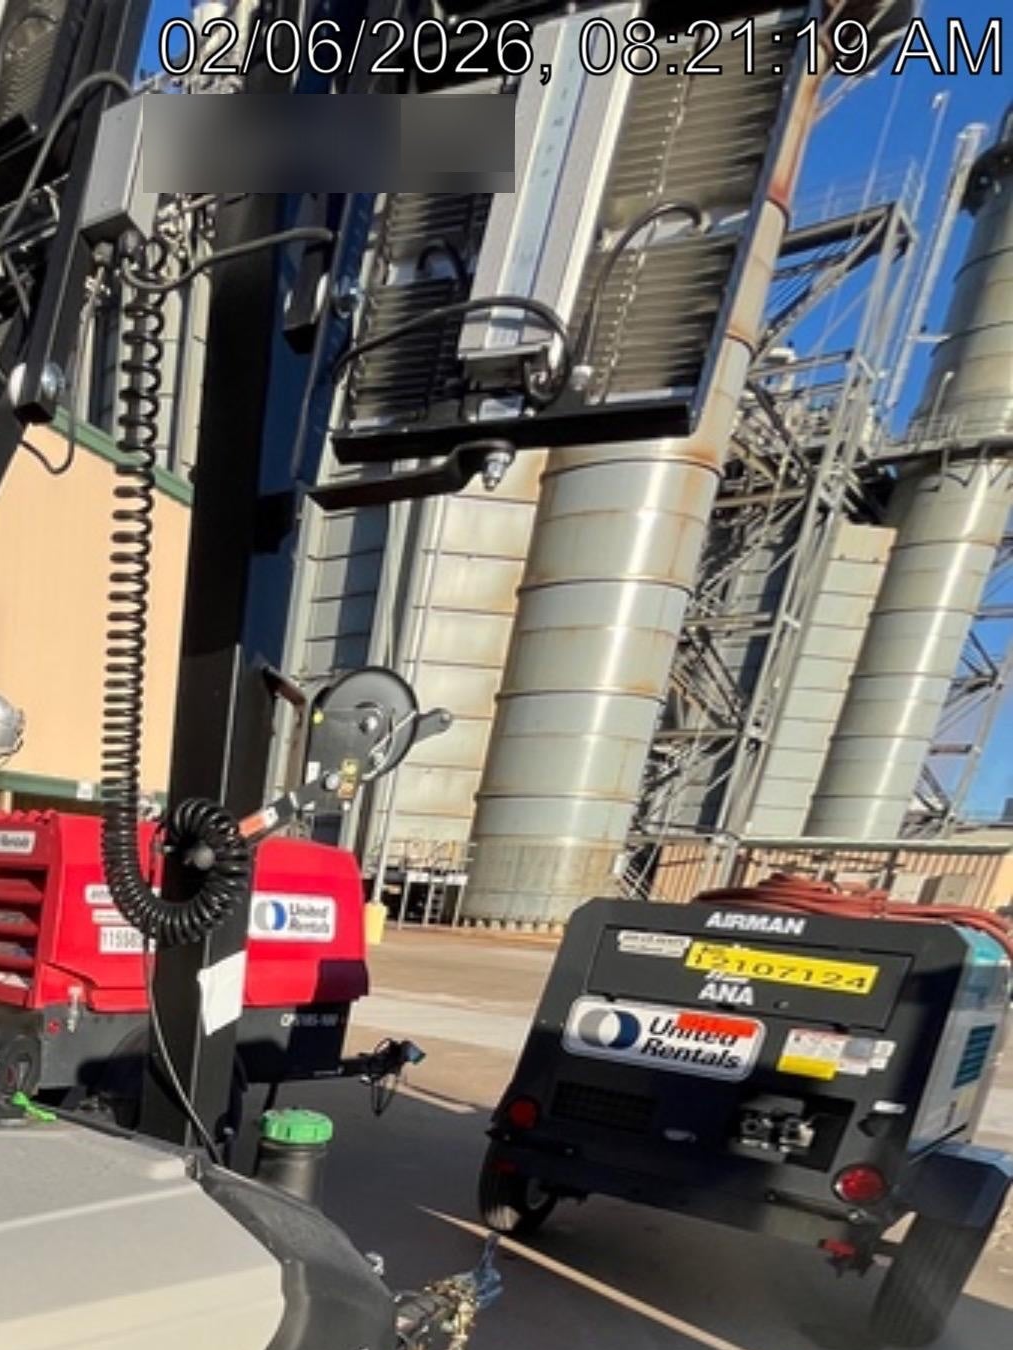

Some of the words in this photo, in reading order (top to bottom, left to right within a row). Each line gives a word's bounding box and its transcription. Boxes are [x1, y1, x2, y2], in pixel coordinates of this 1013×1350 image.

[705, 911, 806, 935] AIRMAN
[698, 982, 754, 1006] ANA
[641, 1037, 741, 1068] Rentals
